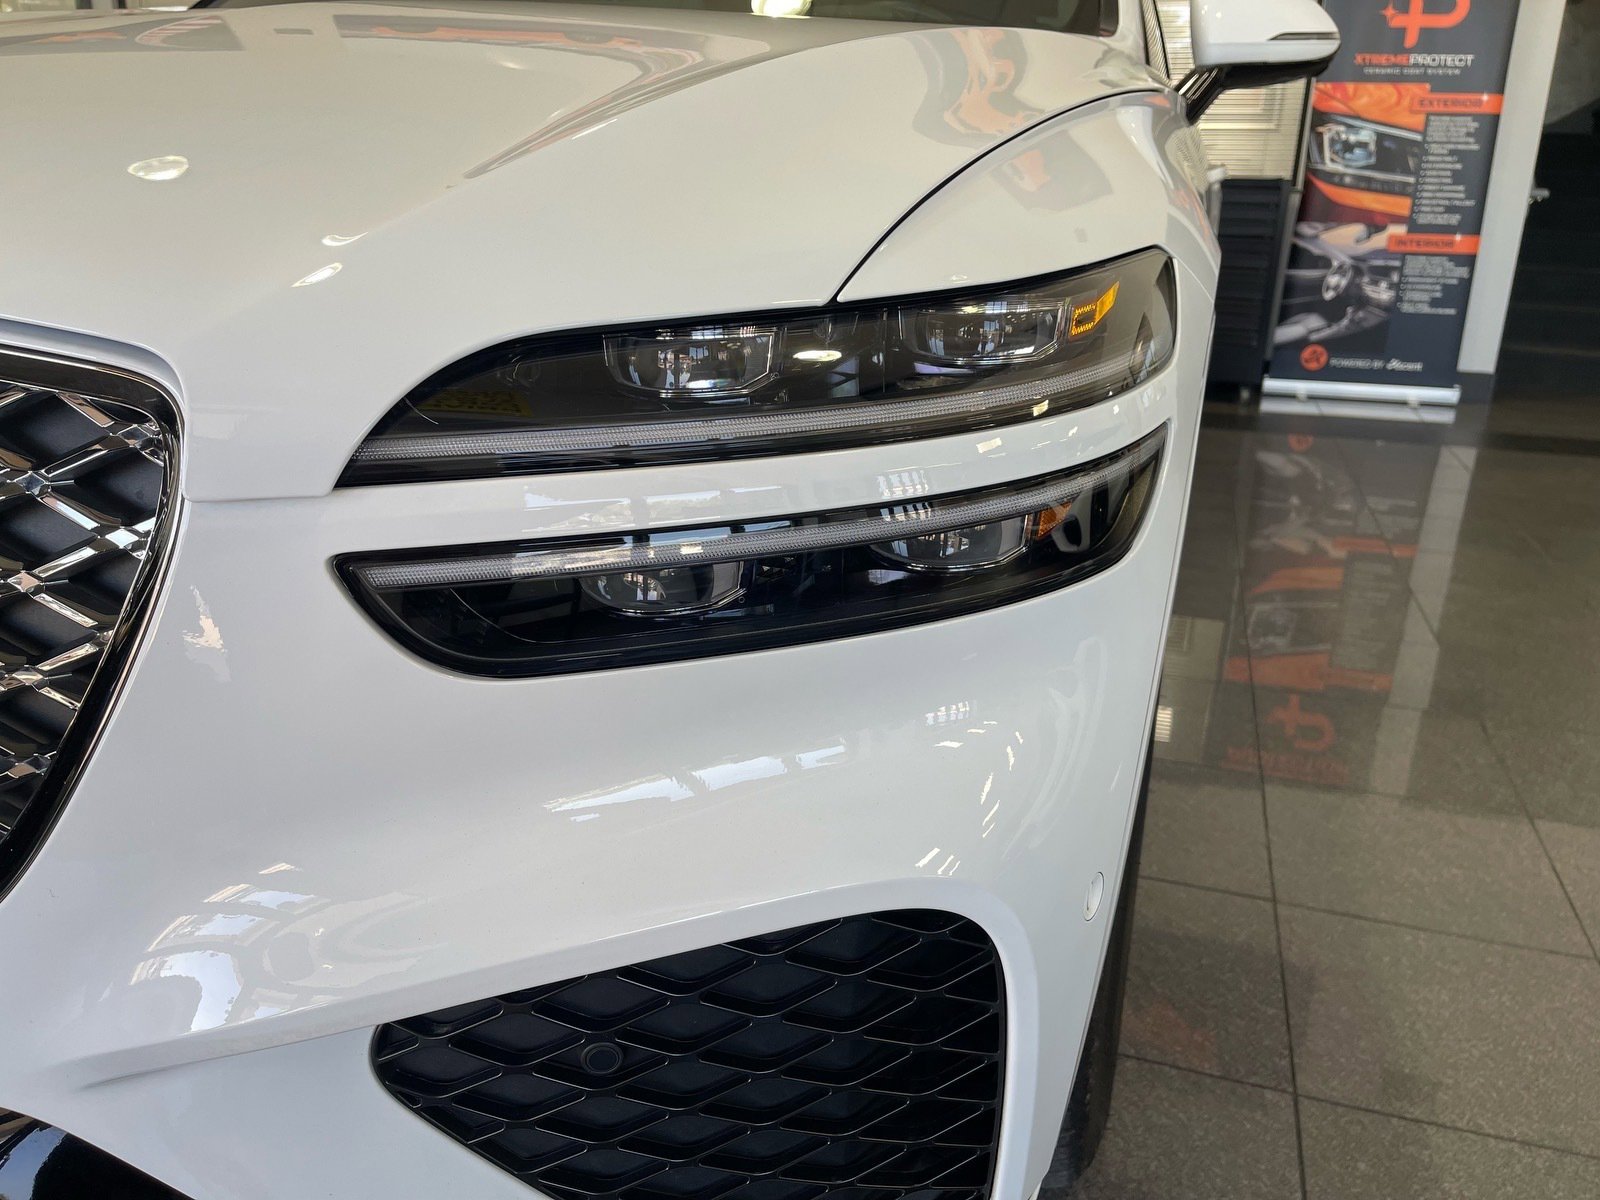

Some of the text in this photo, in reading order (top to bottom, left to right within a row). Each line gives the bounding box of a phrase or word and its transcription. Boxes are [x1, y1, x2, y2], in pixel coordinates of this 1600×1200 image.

[1354, 53, 1475, 67] XTREMEPROTECT
[1418, 98, 1483, 108] EXTERIOR
[1394, 238, 1455, 249] INTERIOR
